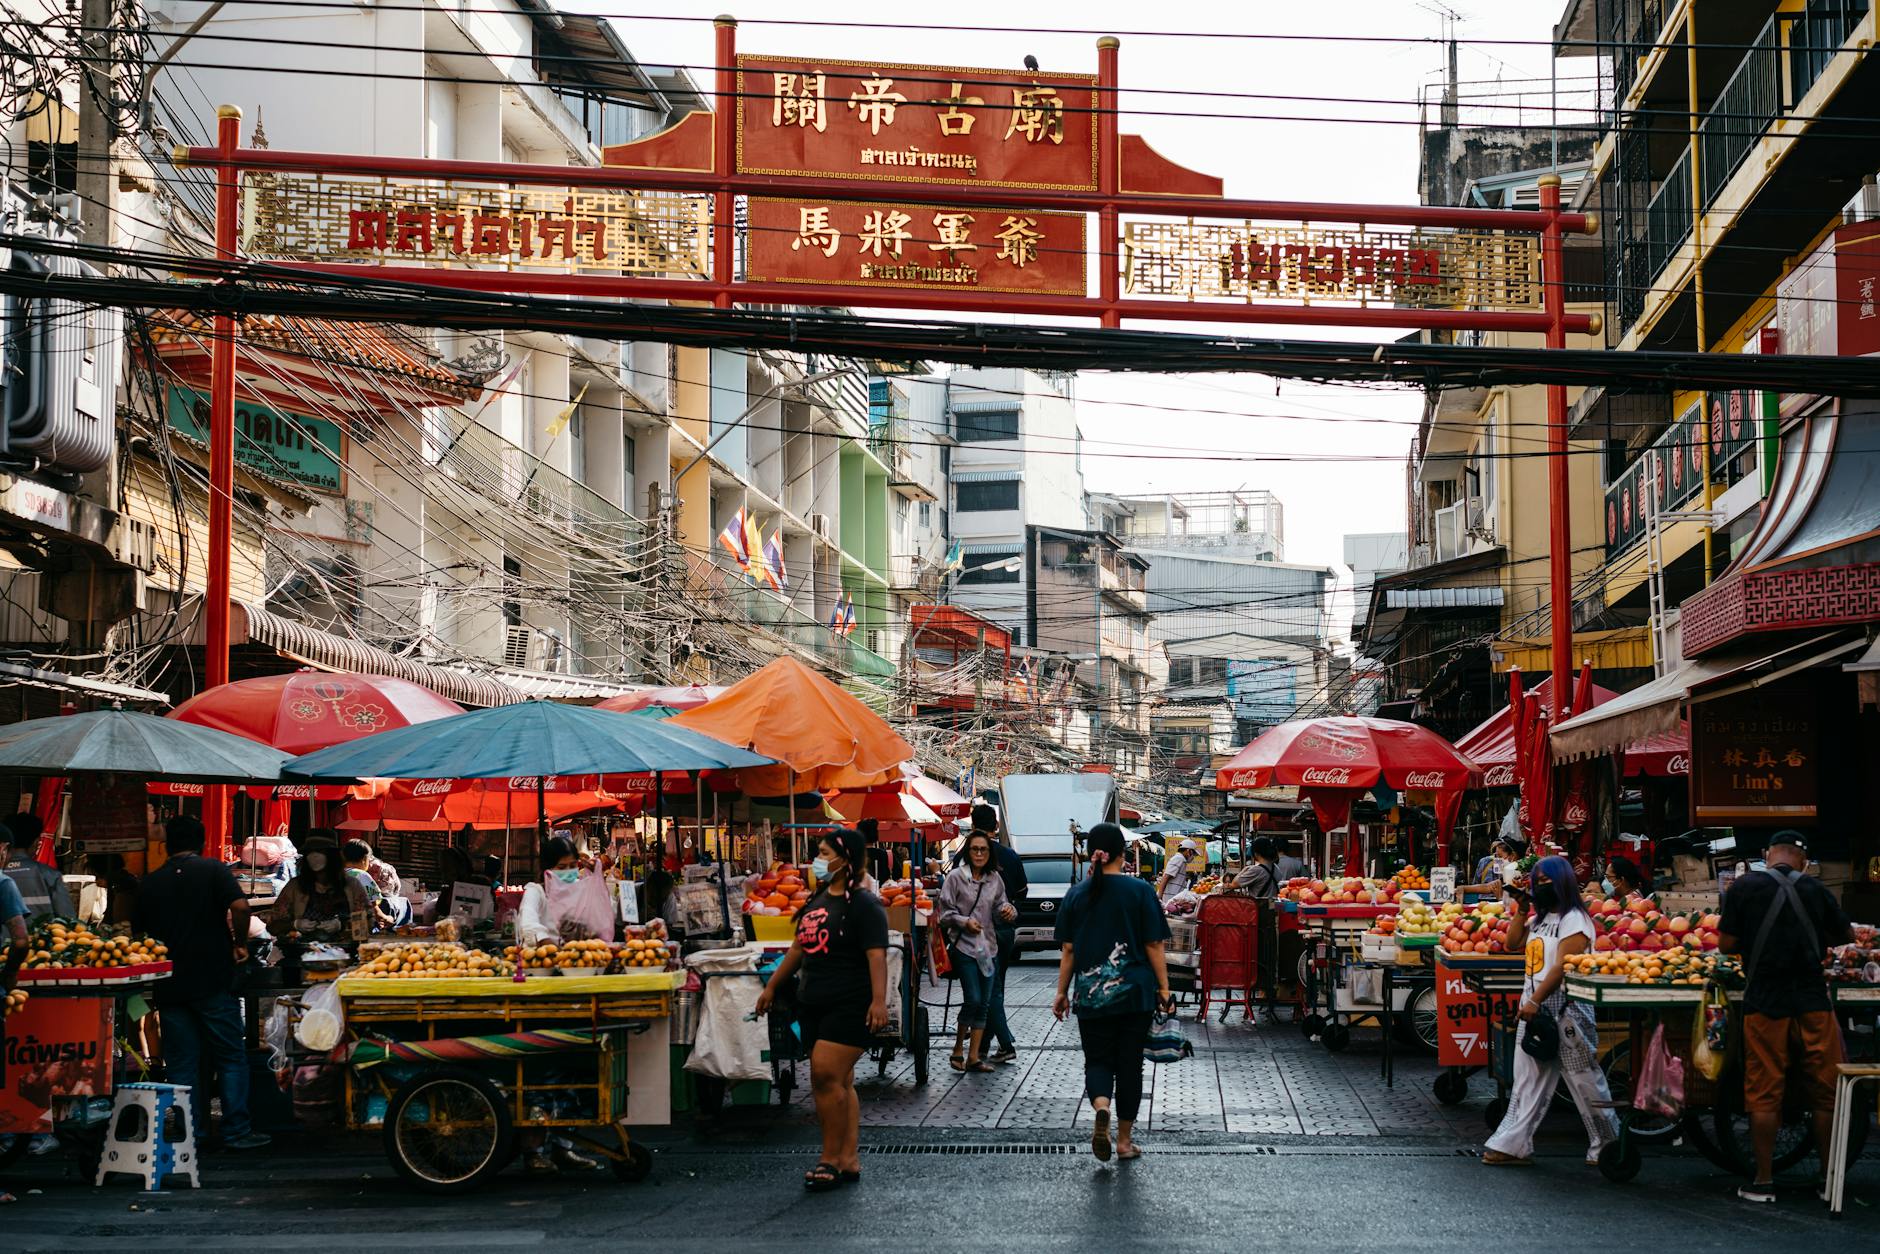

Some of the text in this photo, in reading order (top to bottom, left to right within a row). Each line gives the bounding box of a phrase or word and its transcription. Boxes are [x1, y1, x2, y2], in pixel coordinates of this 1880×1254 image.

[773, 70, 1065, 144] 關帝古廟
[348, 199, 608, 261] ตลาดเก่า
[791, 206, 1046, 267] 馬將軍爺
[1302, 767, 1352, 784] Coca-Cola
[1405, 771, 1445, 788] Coca-Cola
[1733, 773, 1783, 790] Lim's
